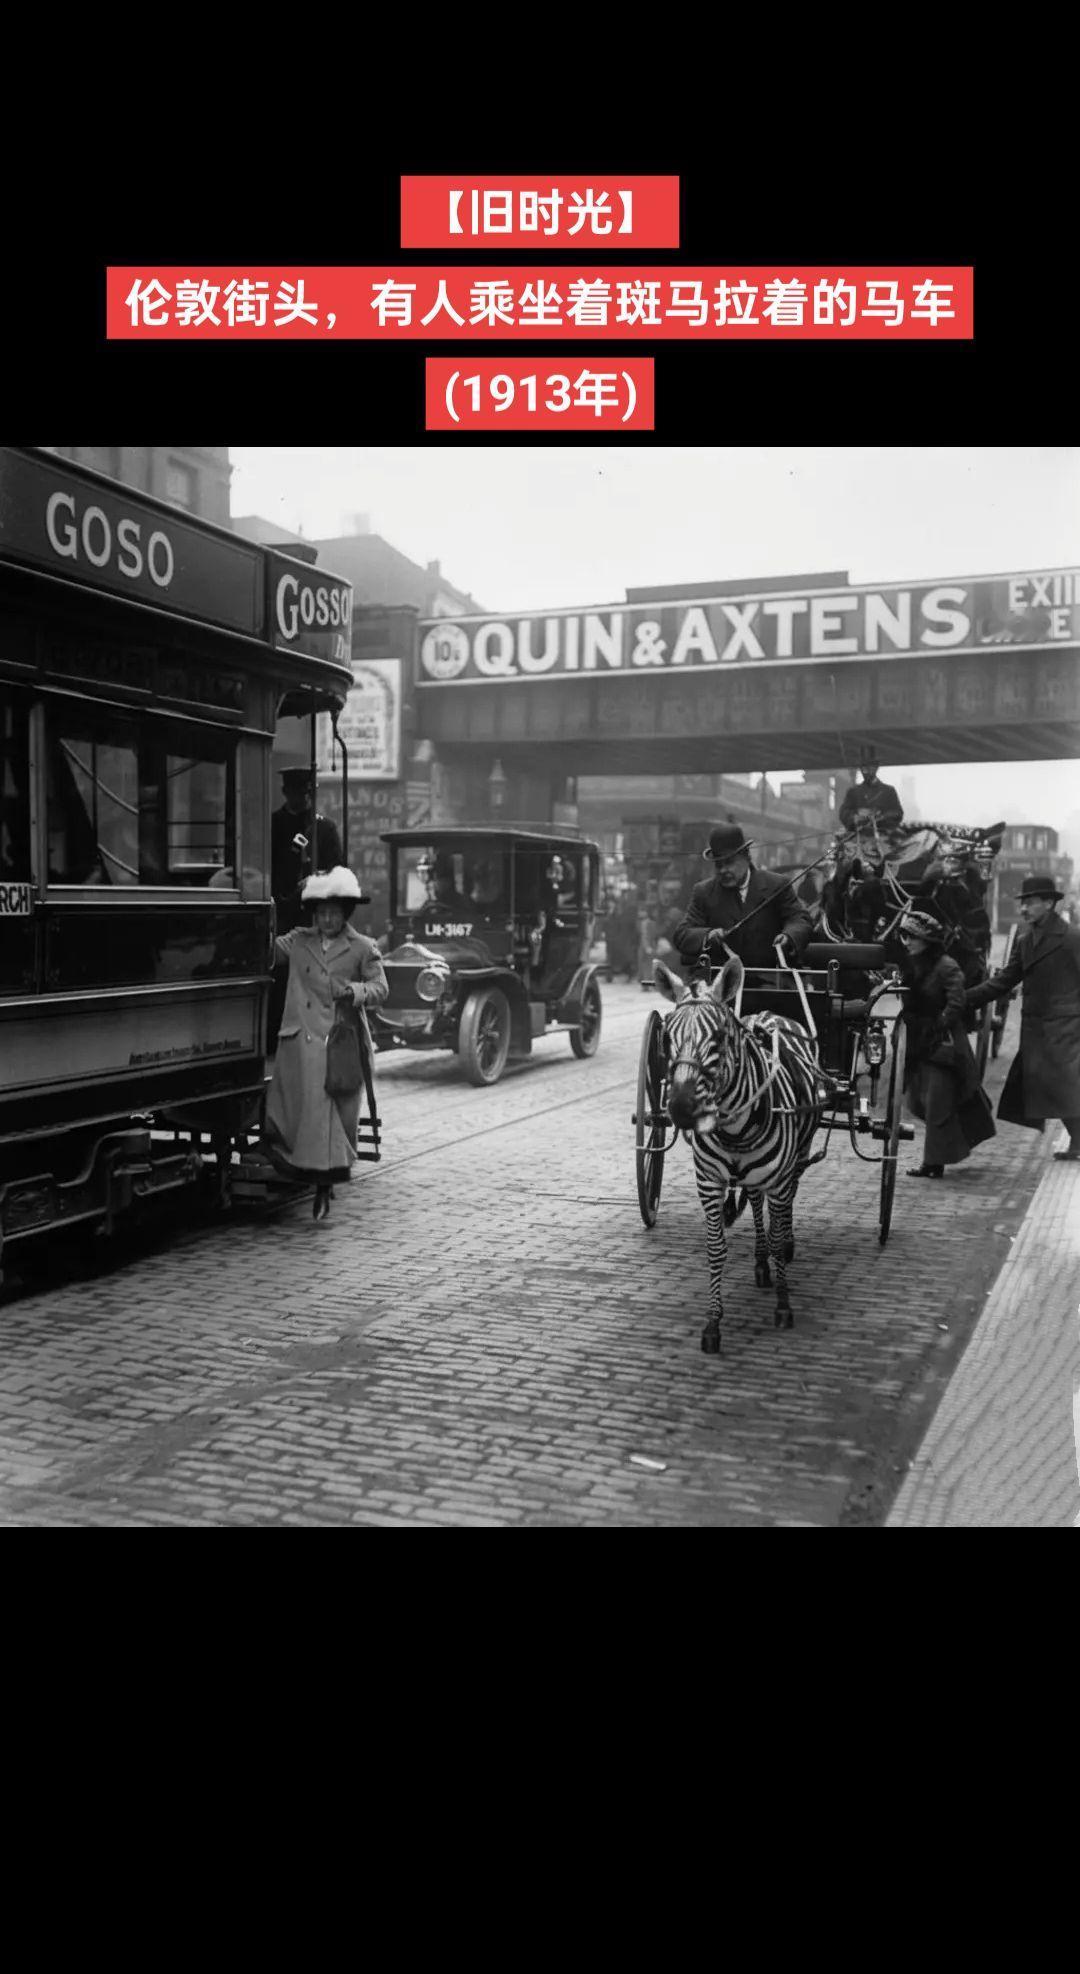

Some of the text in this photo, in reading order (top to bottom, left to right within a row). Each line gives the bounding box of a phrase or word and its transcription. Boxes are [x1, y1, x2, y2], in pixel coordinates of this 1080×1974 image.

[46, 492, 174, 587] GOSO
[473, 587, 971, 676] QUIN & AXTENS
